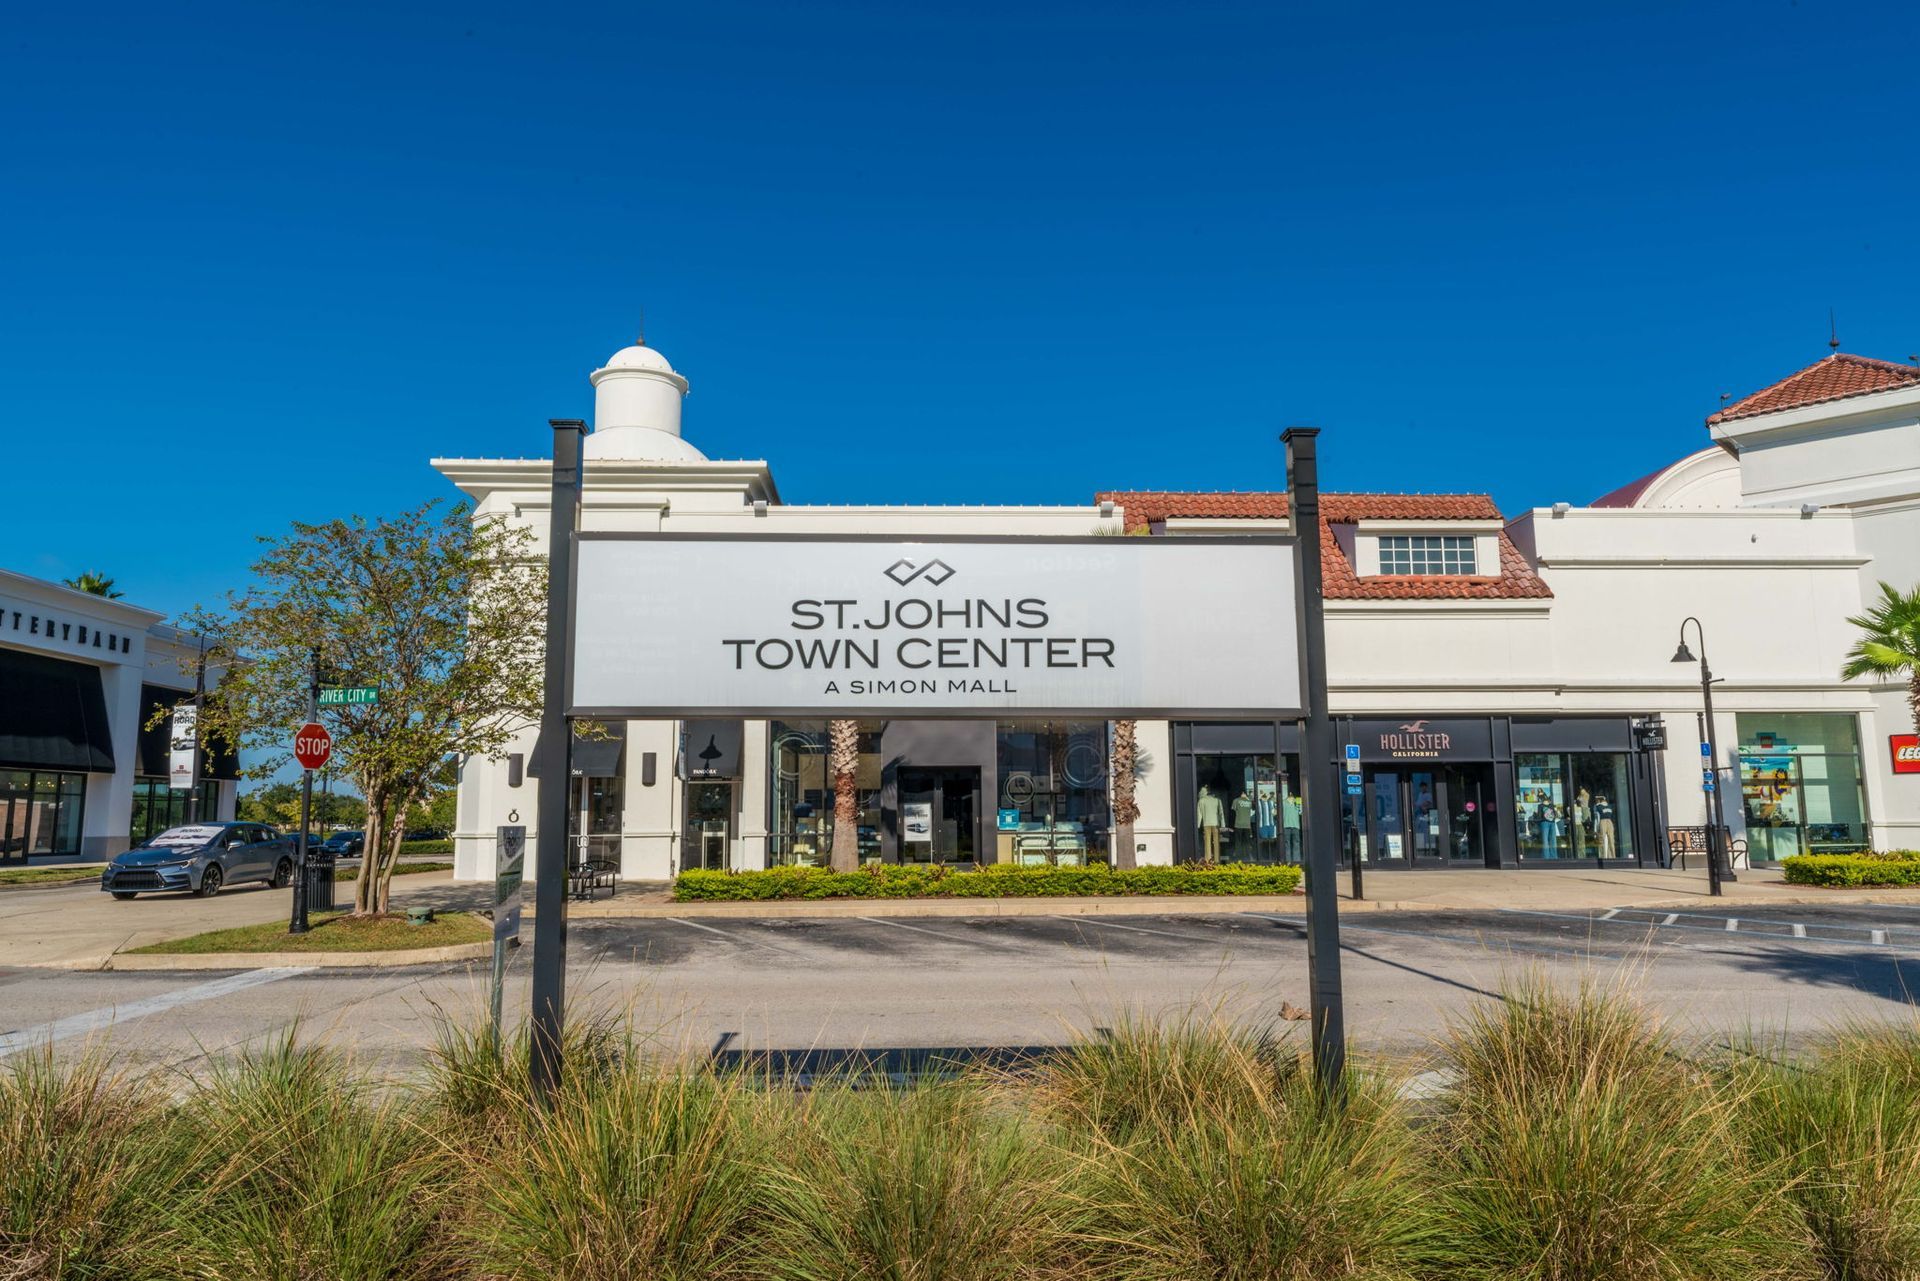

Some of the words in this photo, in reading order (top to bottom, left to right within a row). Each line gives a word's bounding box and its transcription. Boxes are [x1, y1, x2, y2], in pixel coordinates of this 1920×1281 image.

[791, 599, 1049, 630] ST.JOHNS
[722, 638, 879, 670] TOWN
[897, 637, 1115, 669] CENTER
[824, 680, 840, 694] A
[850, 680, 936, 694] SIMON
[948, 679, 1017, 693] MALL
[319, 689, 344, 703] RIVER
[347, 688, 367, 702] CITY
[297, 738, 329, 755] STOP
[1380, 733, 1450, 750] HOLLISTER
